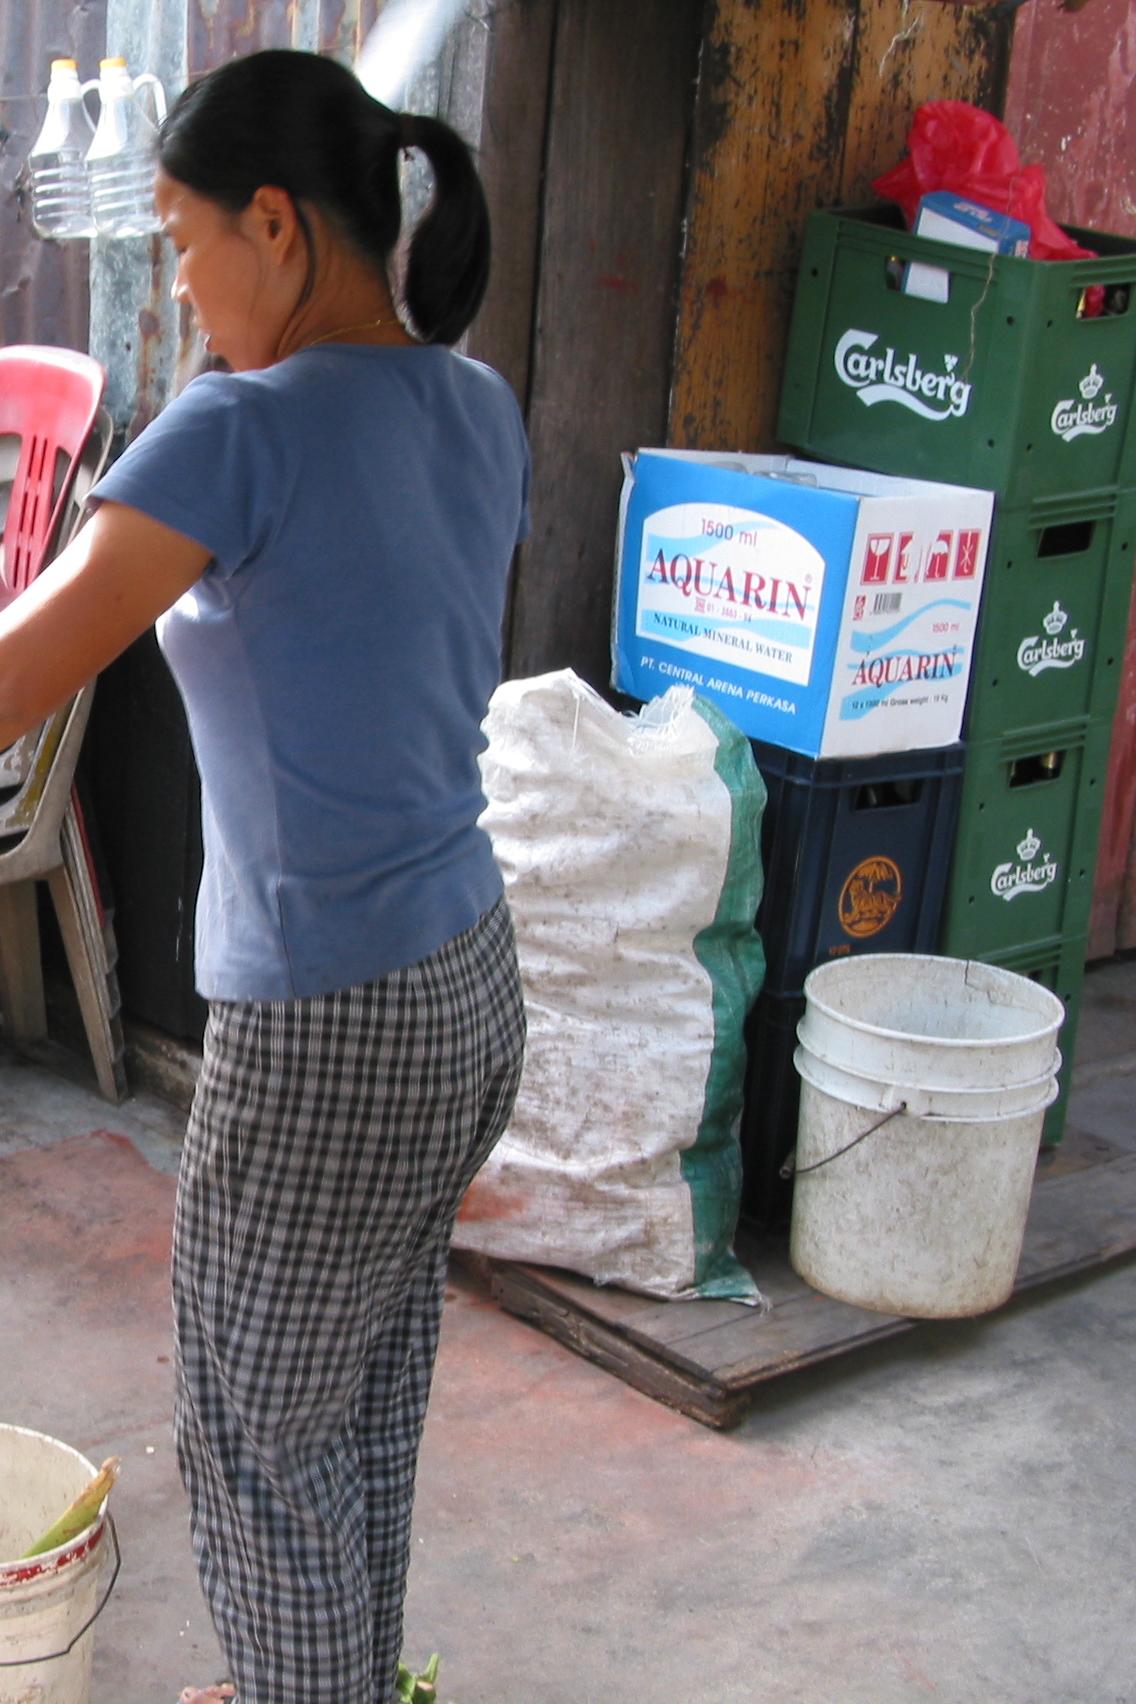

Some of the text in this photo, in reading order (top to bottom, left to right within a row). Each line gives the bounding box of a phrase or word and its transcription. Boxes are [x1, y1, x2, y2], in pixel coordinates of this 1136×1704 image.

[835, 328, 971, 418] Carlsberg
[1051, 399, 1118, 436] Carlsberg
[701, 518, 758, 547] 1500 ml
[647, 548, 812, 621] AQUARIN
[653, 612, 793, 665] NATURAL MINERAL WATER
[1017, 635, 1085, 673] Carlsberg
[640, 655, 796, 715] PT. CENTRAL ARENA PERKASA
[850, 652, 957, 688] AQUARIN
[991, 861, 1058, 897] Carlsberg
